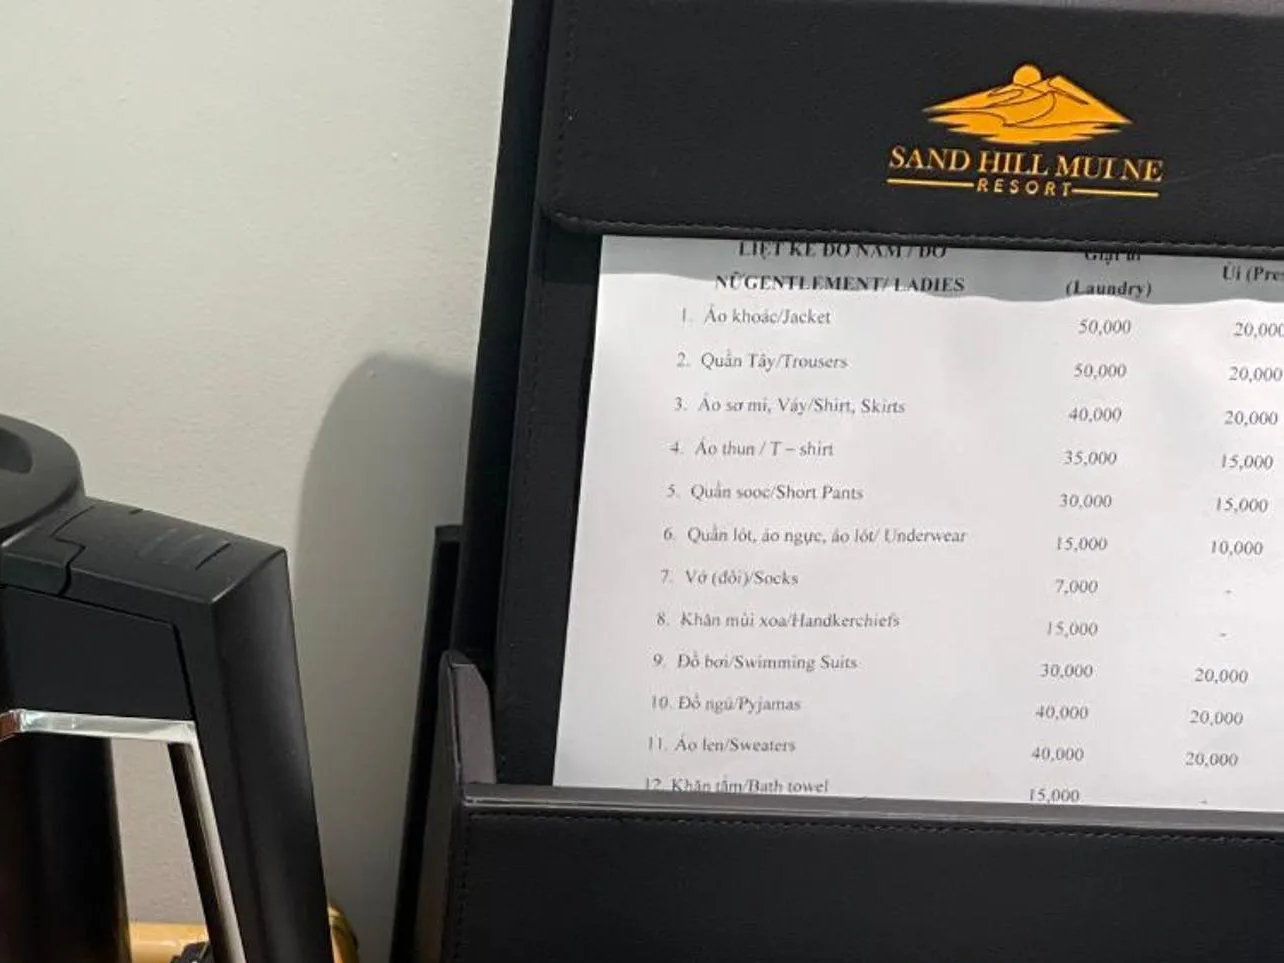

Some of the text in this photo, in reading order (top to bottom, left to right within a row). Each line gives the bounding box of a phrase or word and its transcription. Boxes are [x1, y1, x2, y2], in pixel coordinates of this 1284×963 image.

[888, 145, 1164, 183] SAND HILL MUI NE
[976, 177, 1073, 197] RESORT
[894, 276, 965, 293] LADIES
[1066, 280, 1152, 298] (Laundry)
[704, 304, 727, 324] Áo
[732, 308, 831, 325] khoác/Jacket
[1078, 319, 1131, 336] 50,000
[1233, 321, 1284, 338] 20,000
[676, 353, 690, 368] 2.
[747, 352, 848, 372] Tây/Trousers
[1074, 363, 1127, 380] 50,000
[1228, 366, 1283, 383] 20,000
[674, 397, 688, 412] 3.
[698, 392, 721, 413] Áo
[861, 398, 906, 414] Skirts
[1069, 407, 1122, 423] 40,000
[1224, 410, 1278, 427] 20,000
[669, 441, 684, 455] 4.
[694, 436, 718, 456] Áo
[722, 441, 755, 456] thun
[799, 441, 834, 456] shirt
[1064, 450, 1117, 467] 35,000
[1221, 454, 1273, 471] 15,000
[822, 485, 863, 500] Pants
[1059, 494, 1112, 510] 30,000
[1216, 498, 1268, 514] 15,000
[884, 528, 966, 543] Underwear
[1056, 536, 1108, 552] 15,000
[1210, 540, 1264, 557] 10,000
[1055, 578, 1098, 595] 7,000
[759, 612, 900, 628] xoa/Handkerchiefs
[1046, 621, 1098, 638] 15,000
[820, 655, 858, 669] Suits
[1039, 663, 1093, 680] 30,000
[1194, 667, 1249, 685] 20,000
[1035, 704, 1089, 722] 40,000
[1189, 709, 1244, 727] 20,000
[674, 732, 697, 752] Áo
[703, 736, 796, 752] len/Sweaters
[1031, 747, 1085, 763] 40,000
[1185, 751, 1239, 768] 20,000
[788, 779, 829, 794] towel
[1029, 788, 1080, 804] 15,000
